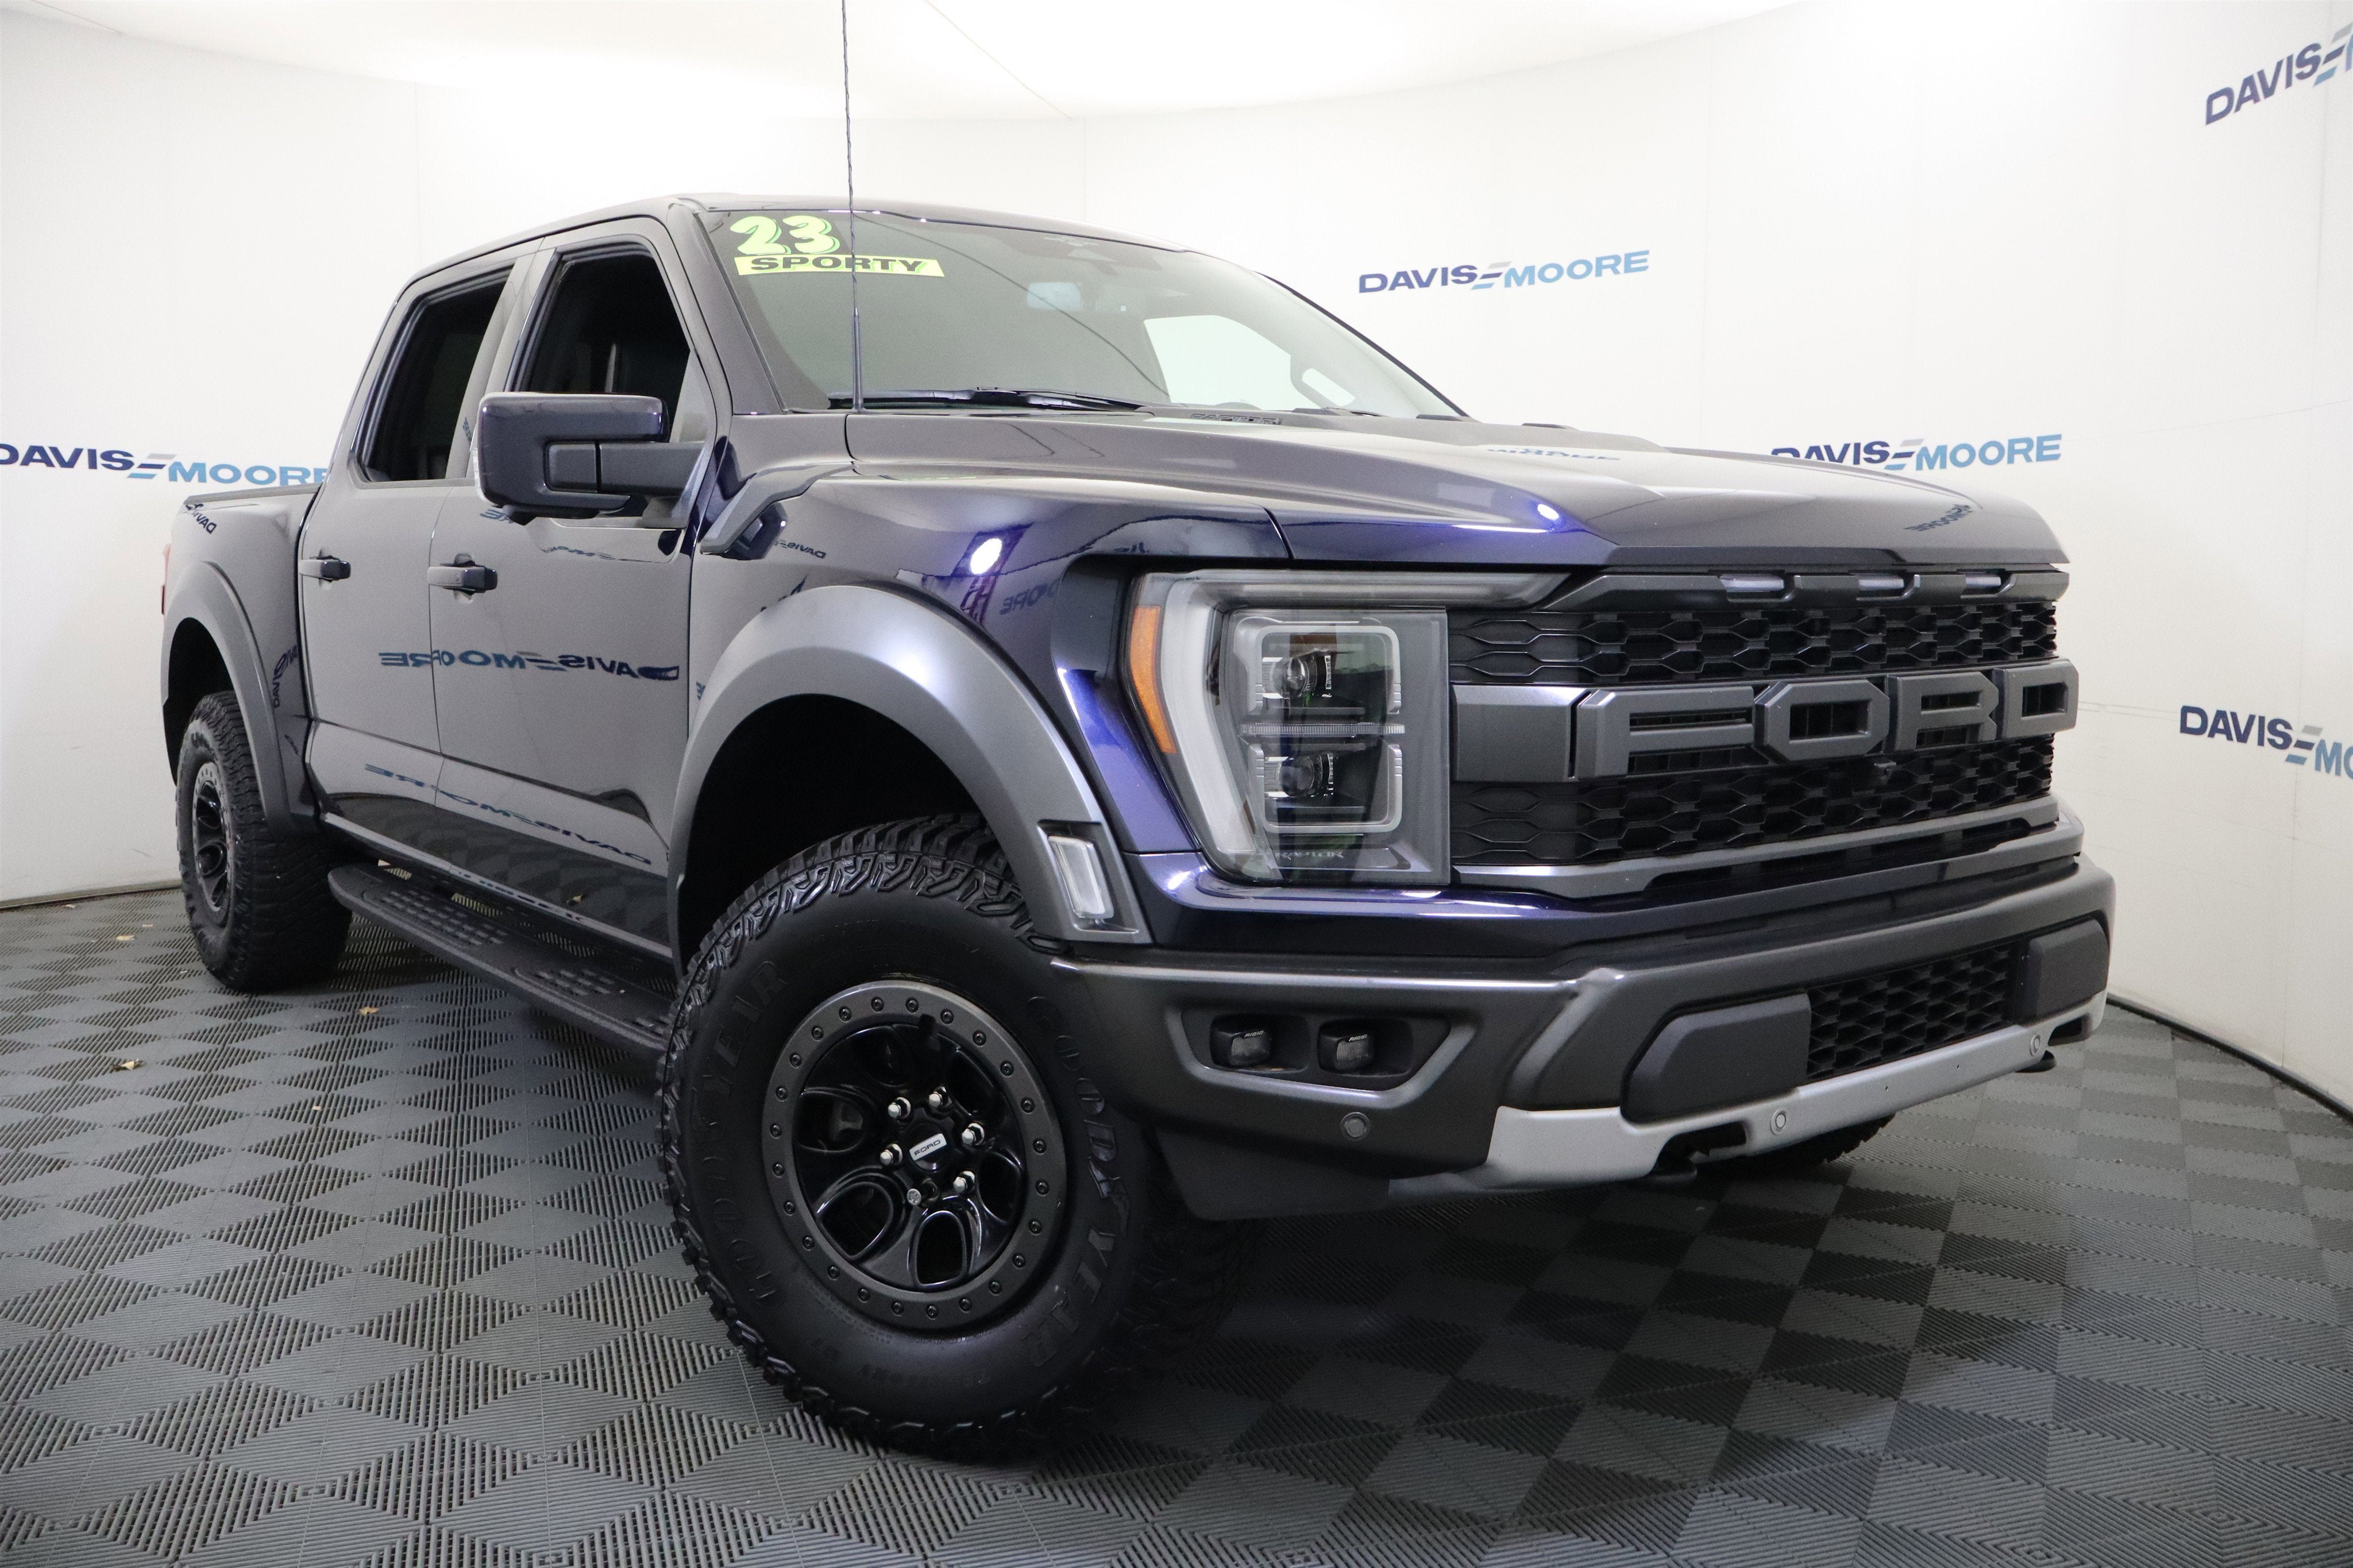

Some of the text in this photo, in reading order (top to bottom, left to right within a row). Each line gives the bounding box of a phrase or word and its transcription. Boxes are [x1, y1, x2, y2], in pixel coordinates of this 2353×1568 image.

[2205, 43, 2321, 125] DAVIS
[730, 214, 840, 255] 23
[750, 254, 928, 273] SPORTY
[1359, 250, 1650, 293] DAVIS MOORE
[1916, 434, 2062, 470] MOORE
[1576, 657, 2079, 779] FORD
[2180, 705, 2293, 750] DAVIS
[1244, 1030, 1264, 1038] RIGID
[1348, 1034, 1368, 1042] RIGID
[914, 1140, 941, 1156] FORD
